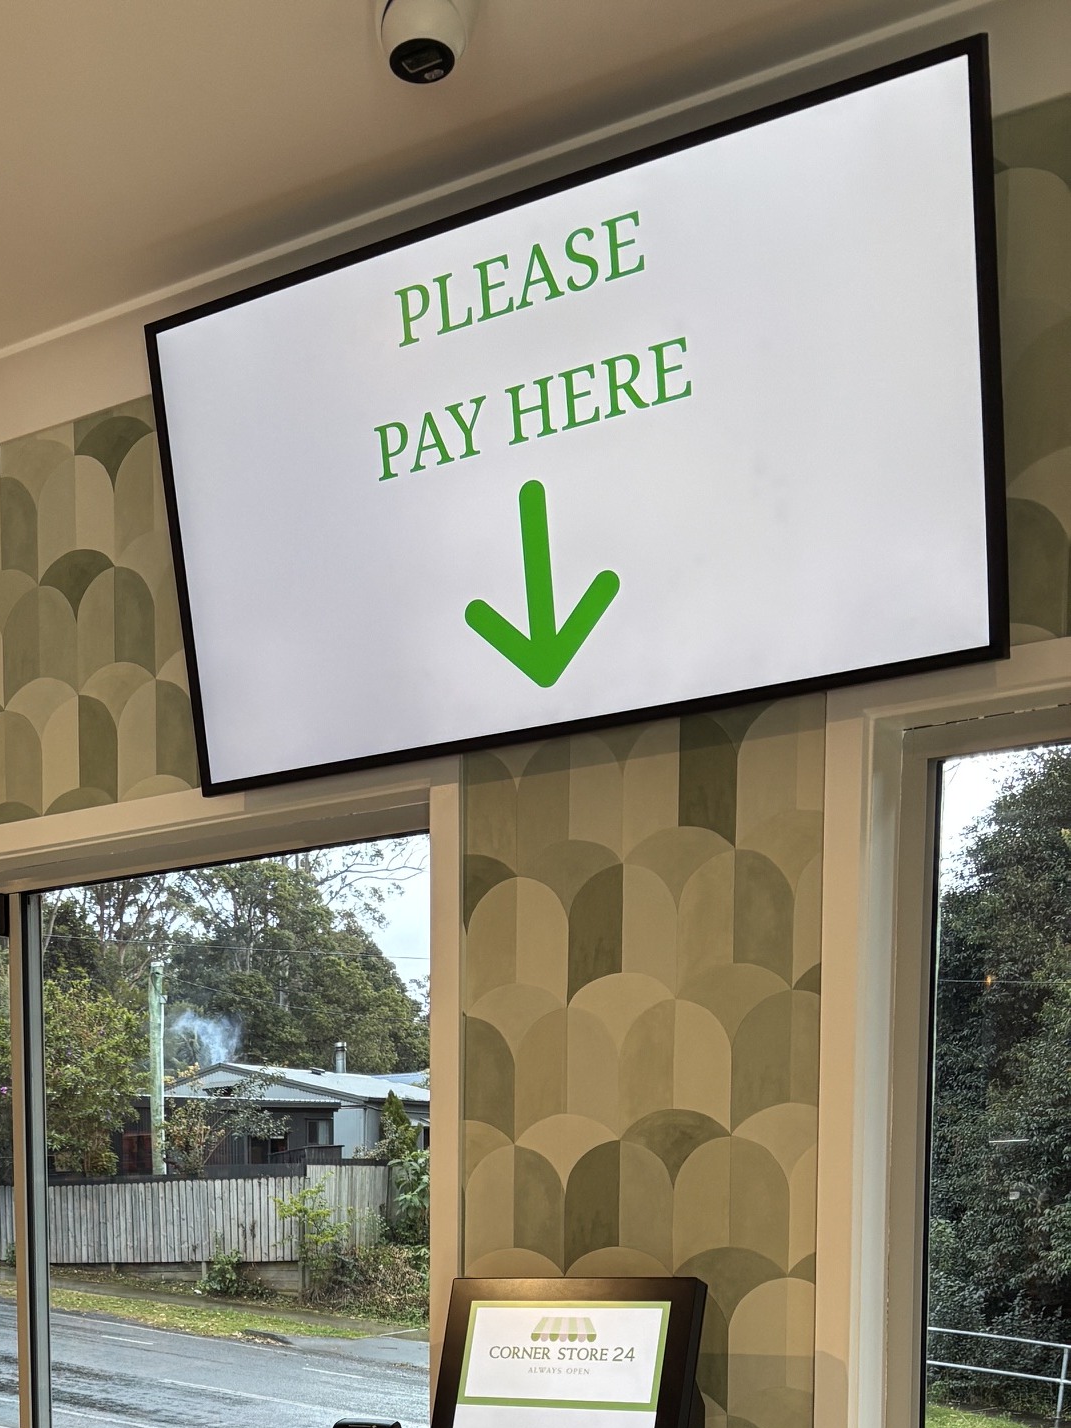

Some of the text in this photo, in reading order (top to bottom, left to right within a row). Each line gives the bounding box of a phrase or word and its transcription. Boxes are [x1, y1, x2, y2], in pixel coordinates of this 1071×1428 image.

[394, 210, 645, 347] PLEASE
[373, 337, 693, 482] PAY HERE
[489, 1346, 635, 1362] CORNER STORE 24
[528, 1367, 590, 1375] ALWAYS OPEN
